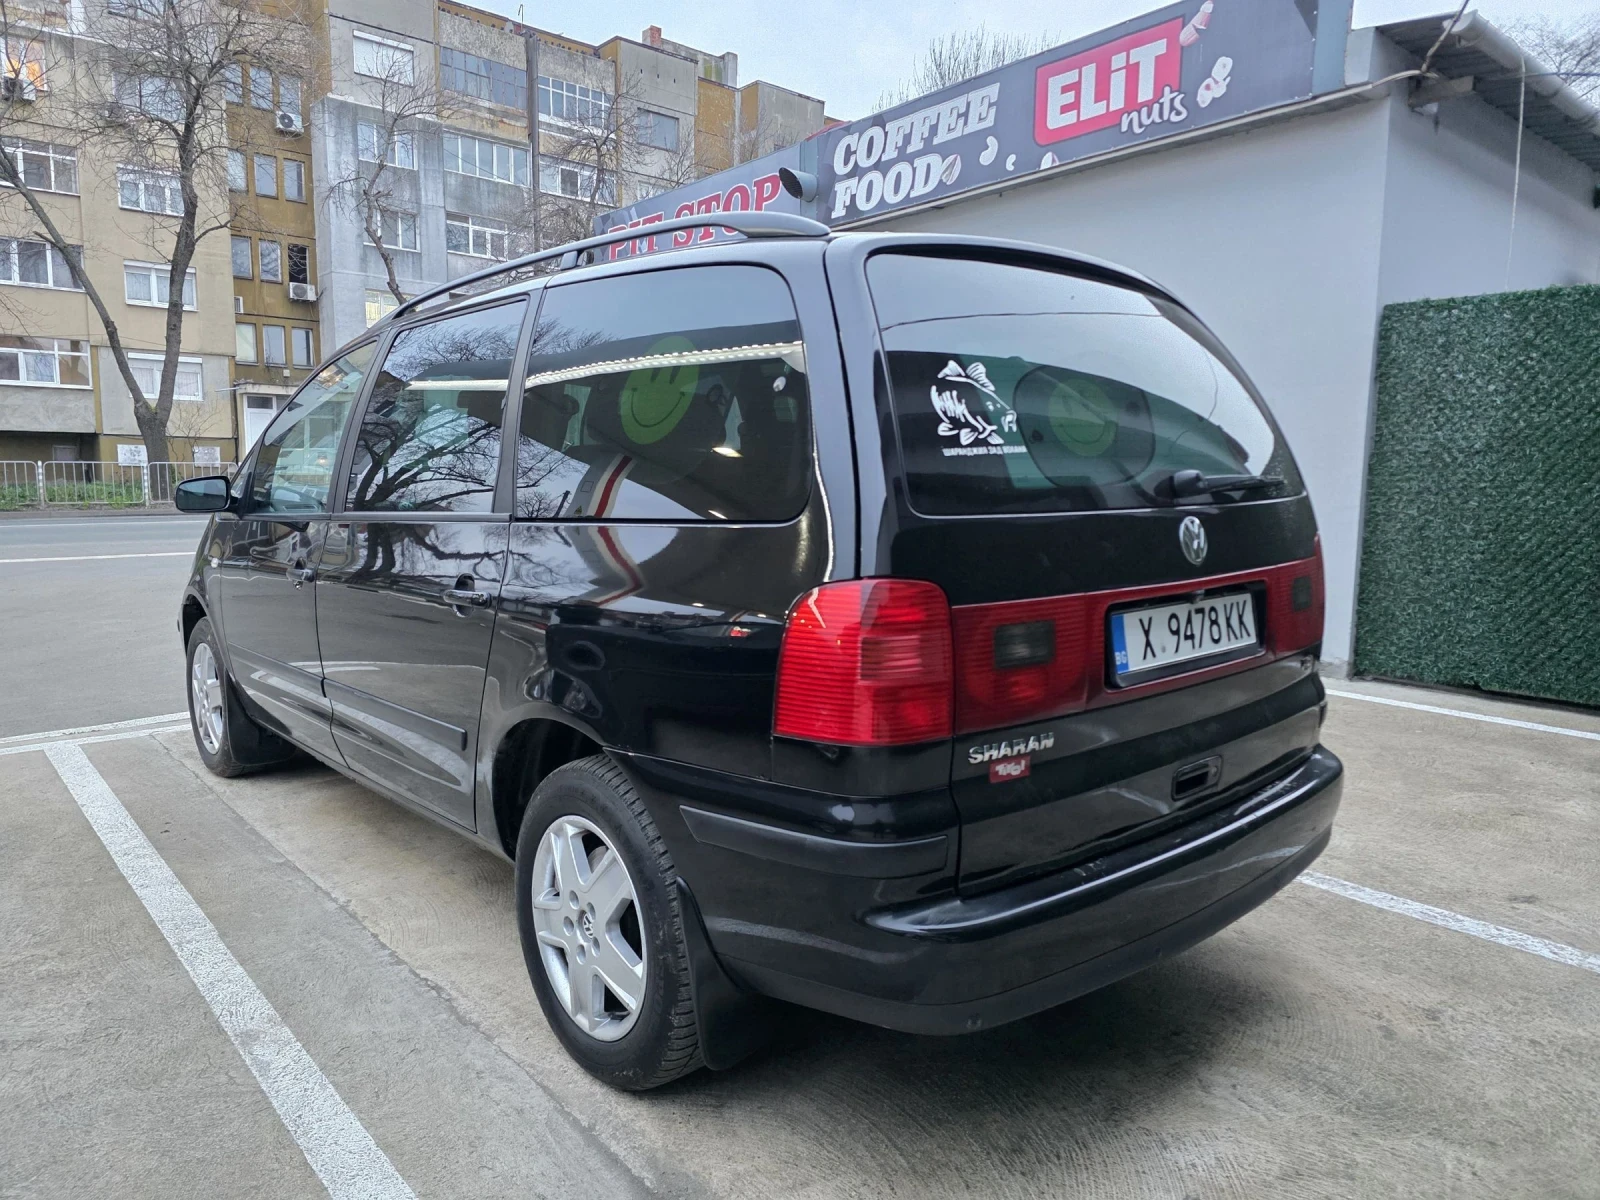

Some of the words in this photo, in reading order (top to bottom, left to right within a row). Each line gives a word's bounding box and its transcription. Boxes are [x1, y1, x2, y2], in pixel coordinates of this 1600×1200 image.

[833, 82, 1000, 175] COFFEE
[1120, 85, 1188, 134] nuts
[831, 152, 943, 219] FOOD
[608, 212, 665, 261] PIT
[672, 173, 782, 248] STOP
[1115, 650, 1127, 665] BG
[968, 732, 1055, 764] SHARAN
